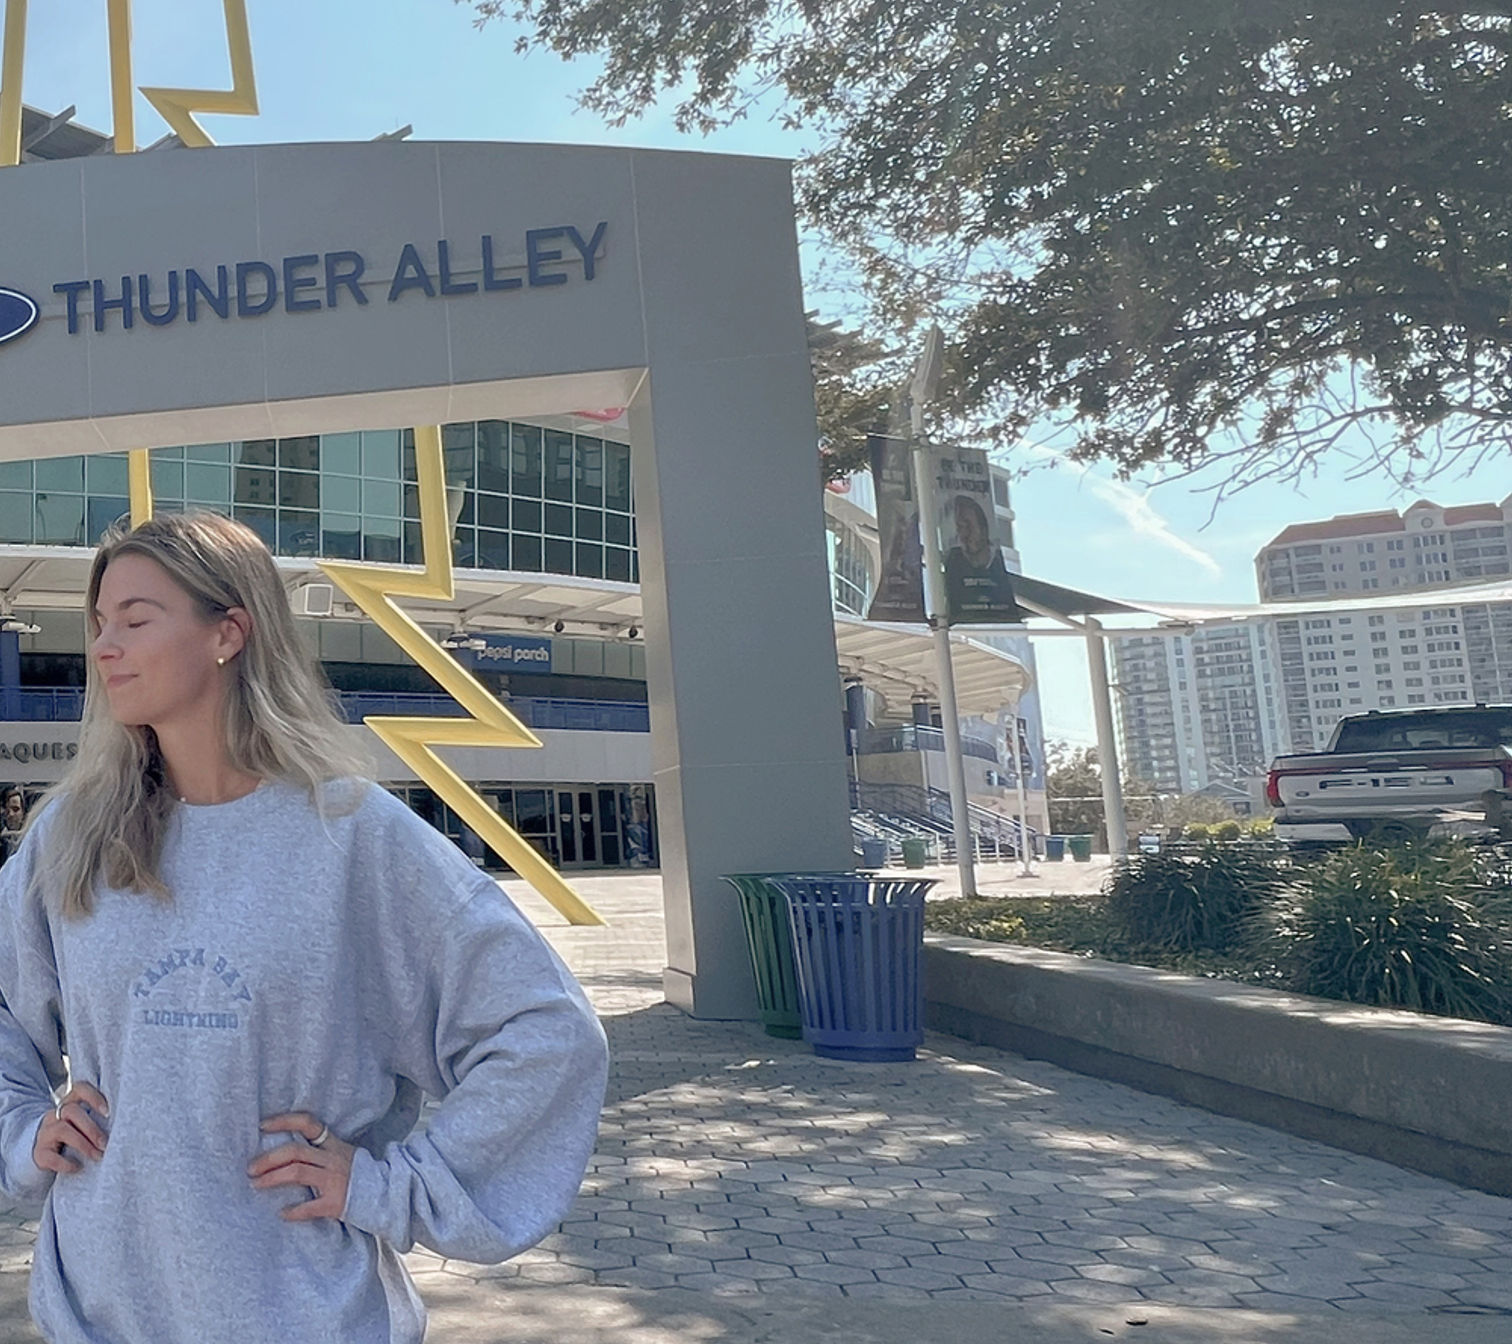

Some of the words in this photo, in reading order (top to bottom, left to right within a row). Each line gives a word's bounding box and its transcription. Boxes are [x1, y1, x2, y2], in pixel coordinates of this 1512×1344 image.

[52, 250, 369, 335] THUNDER
[387, 221, 609, 303] ALLEY
[477, 645, 513, 661] pepsi
[513, 646, 549, 663] porch
[1319, 775, 1455, 790] F-150
[133, 948, 206, 998] TAMPA
[212, 955, 253, 1002] BAY
[143, 1009, 239, 1030] LIGHTNING
